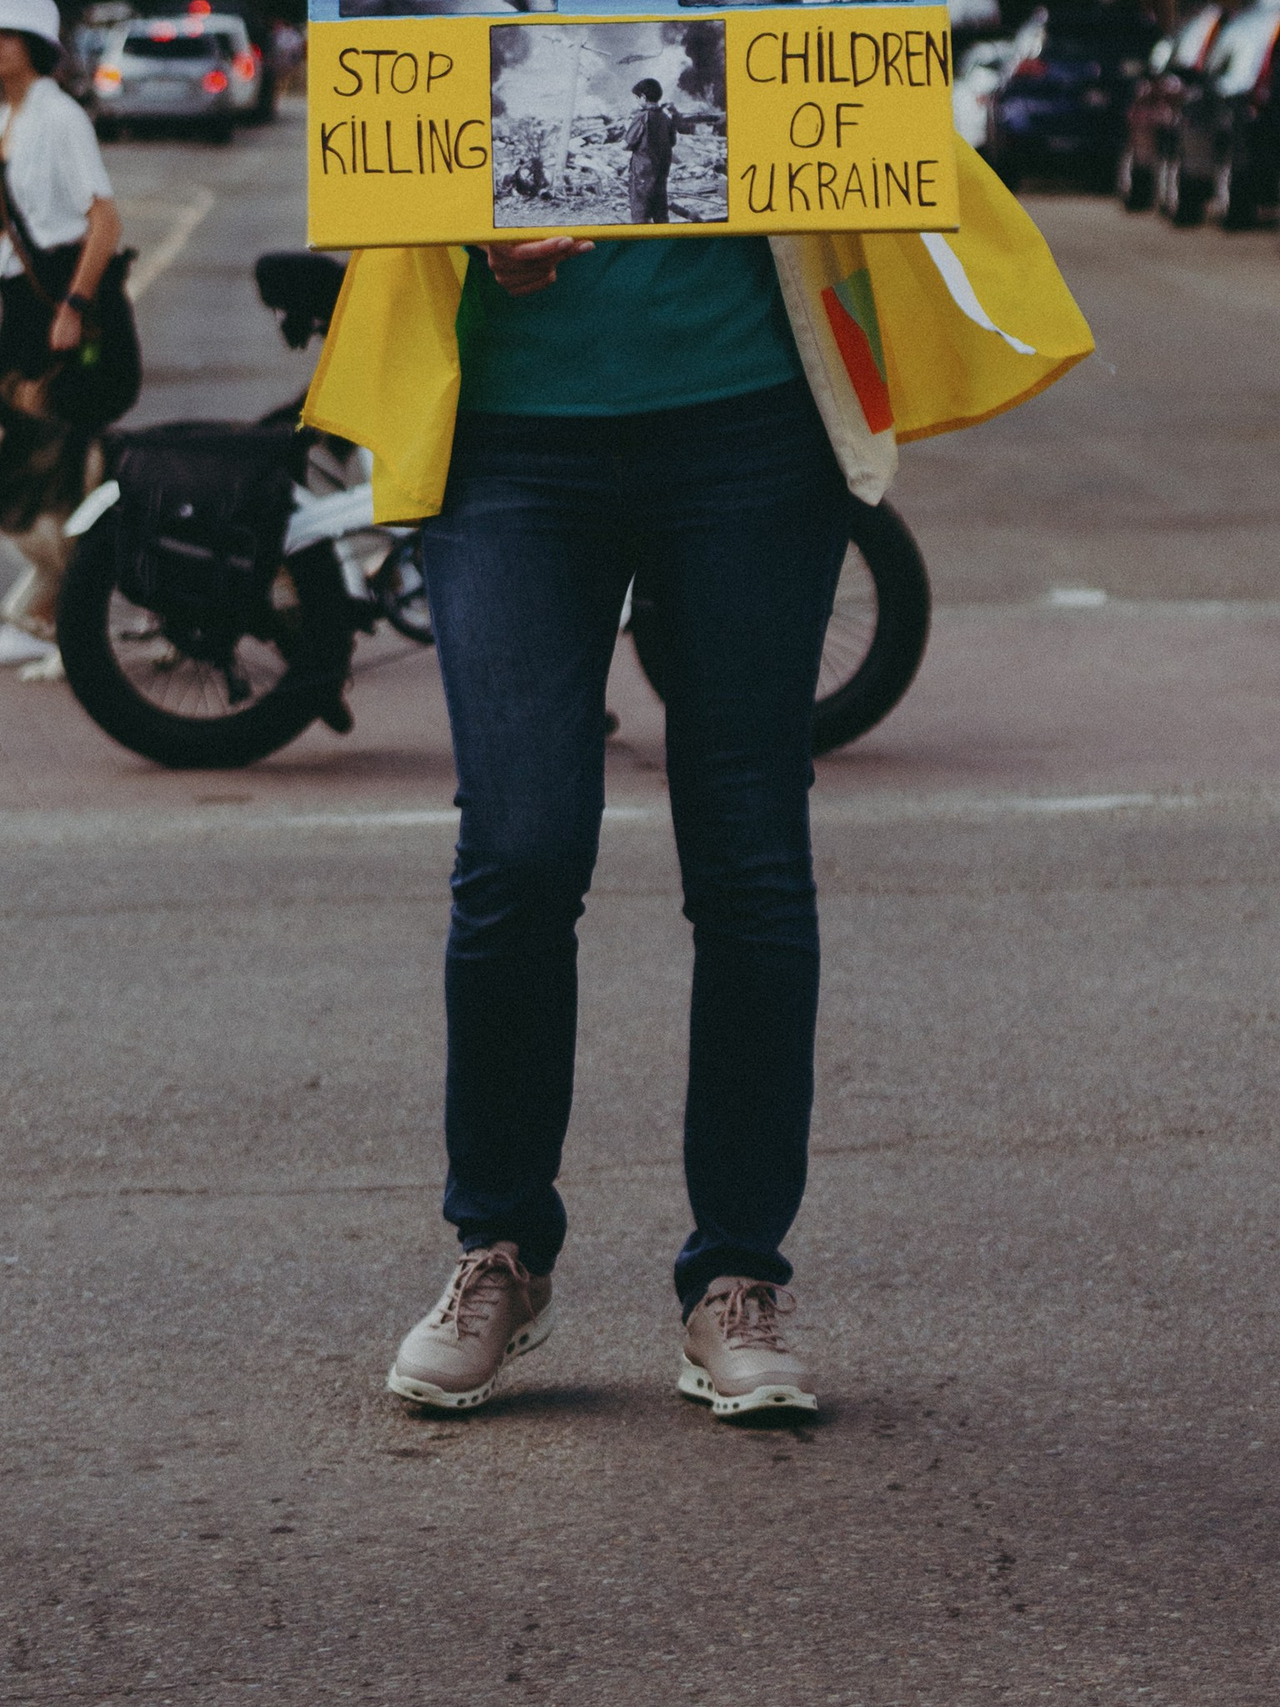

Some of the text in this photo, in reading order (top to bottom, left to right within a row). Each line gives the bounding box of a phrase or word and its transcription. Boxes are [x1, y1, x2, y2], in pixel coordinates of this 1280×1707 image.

[333, 46, 454, 97] STOP
[745, 25, 950, 88] CHILDREN
[320, 114, 488, 175] KILLING
[789, 100, 864, 149] OF
[739, 156, 940, 214] UKRAINE
